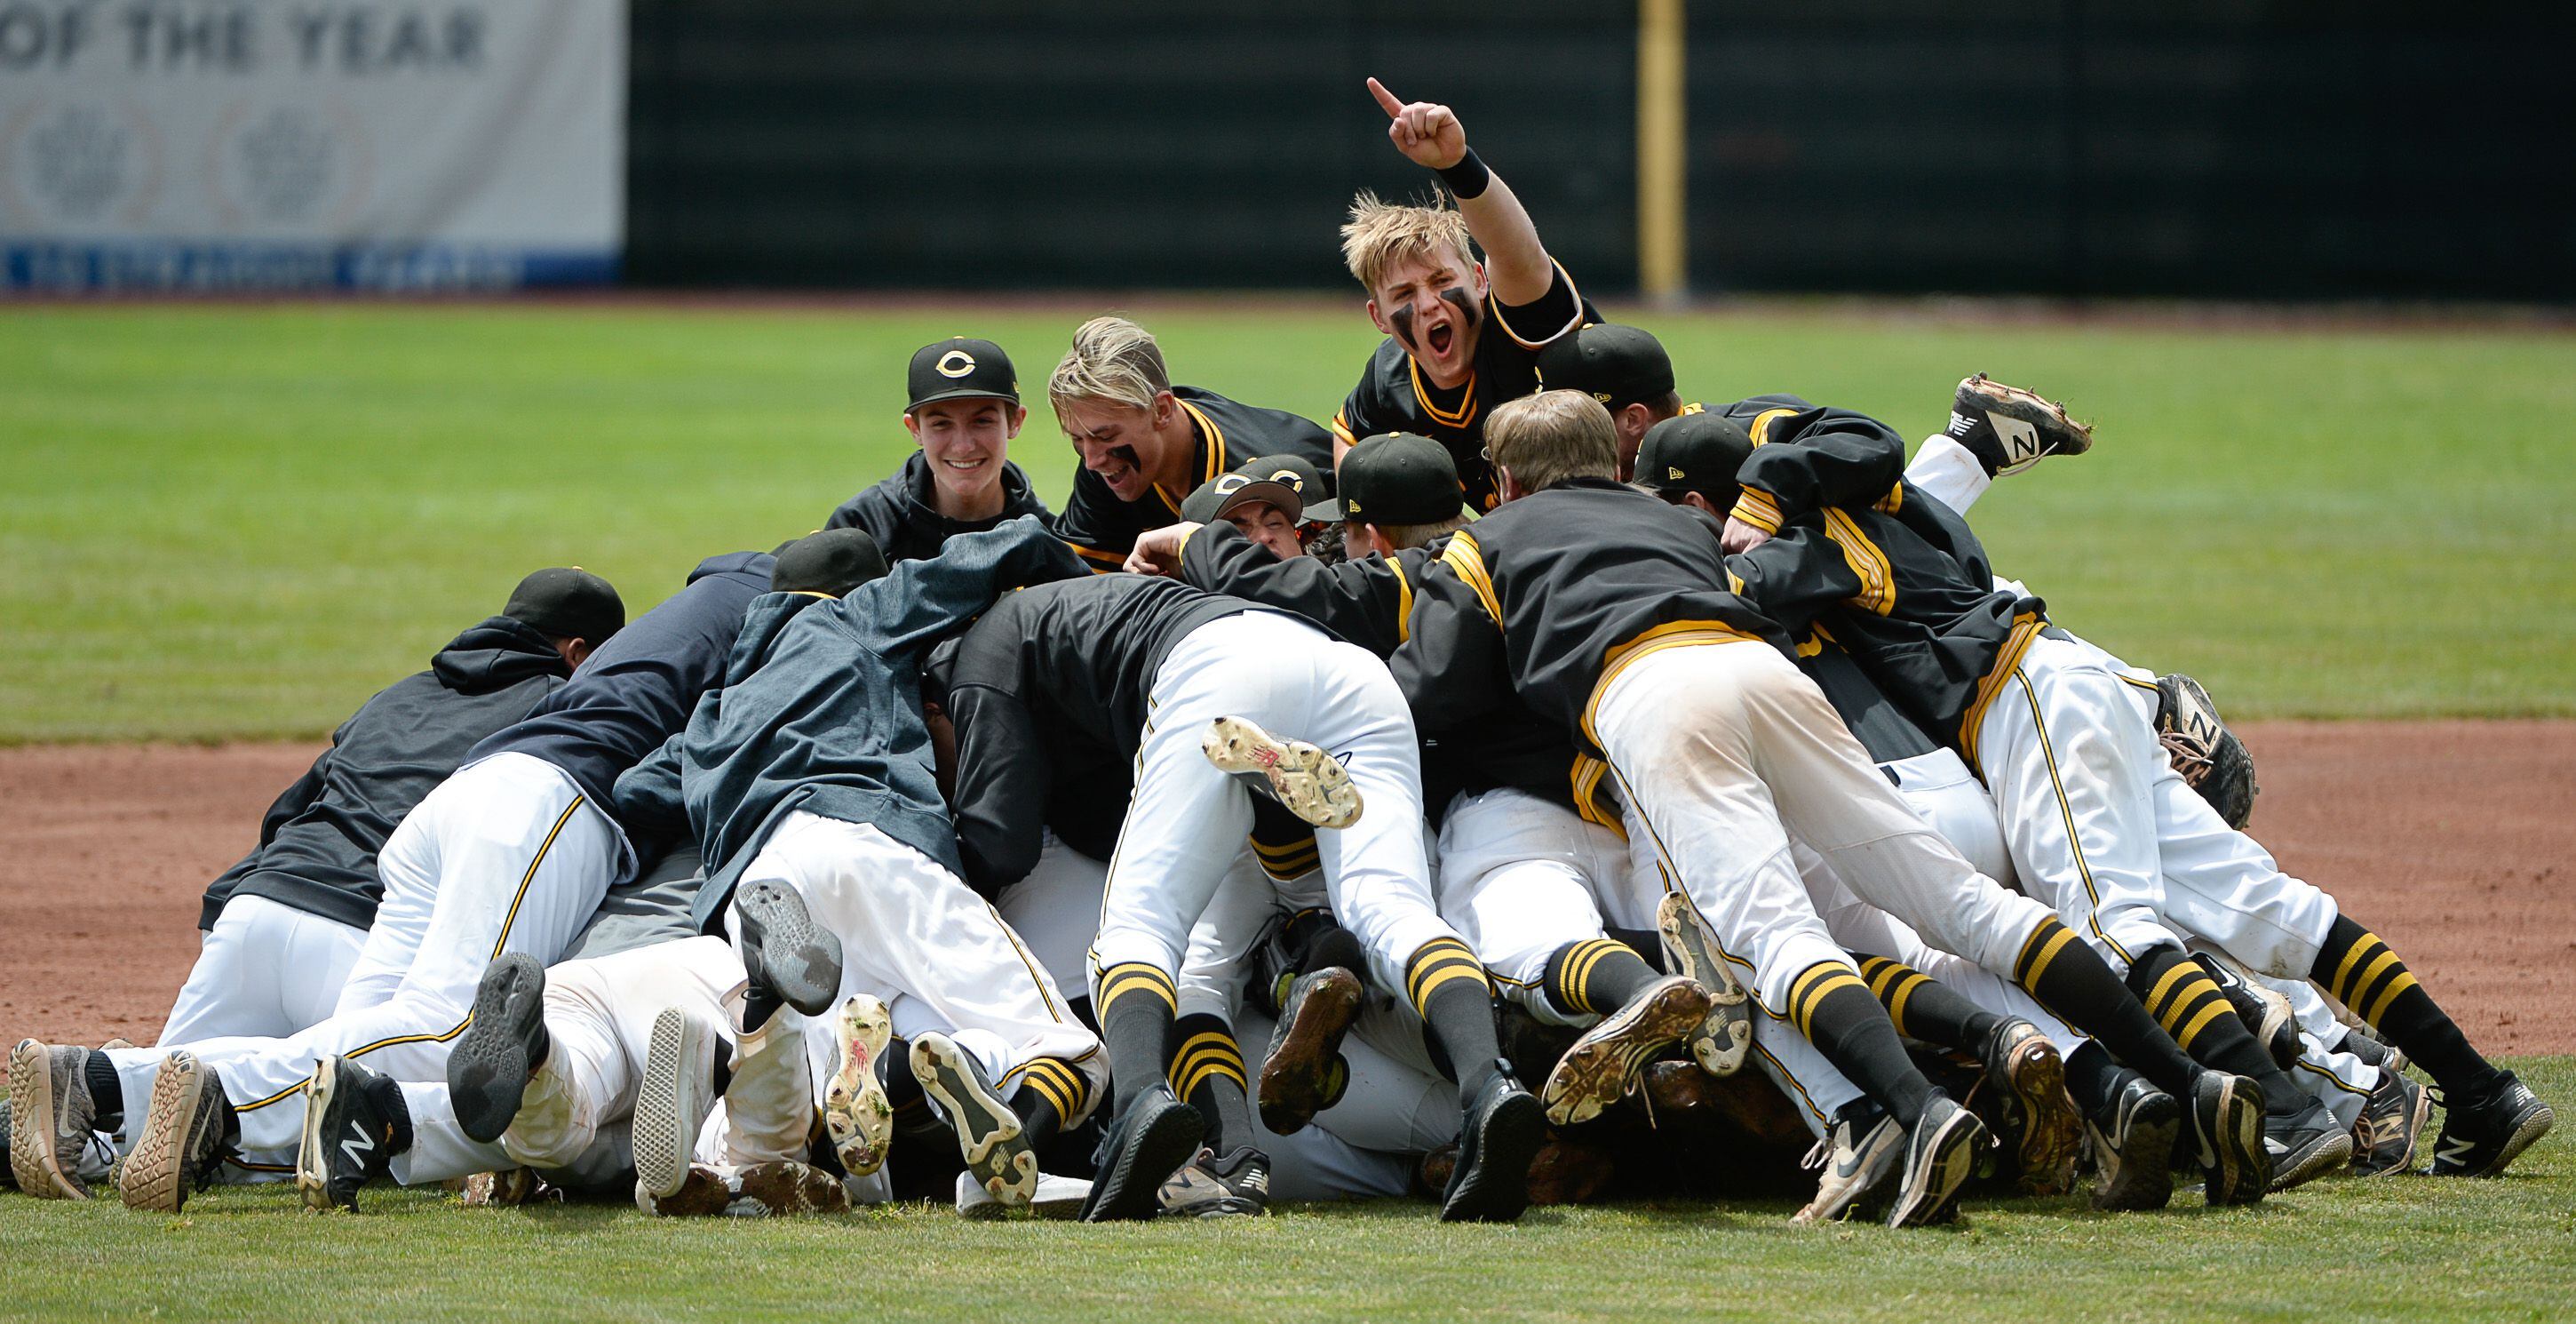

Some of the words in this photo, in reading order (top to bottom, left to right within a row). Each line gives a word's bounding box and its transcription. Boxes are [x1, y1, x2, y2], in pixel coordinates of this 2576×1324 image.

[0, 8, 84, 70] OF
[122, 8, 255, 74] THE
[290, 11, 486, 75] YEAR
[935, 350, 975, 378] C
